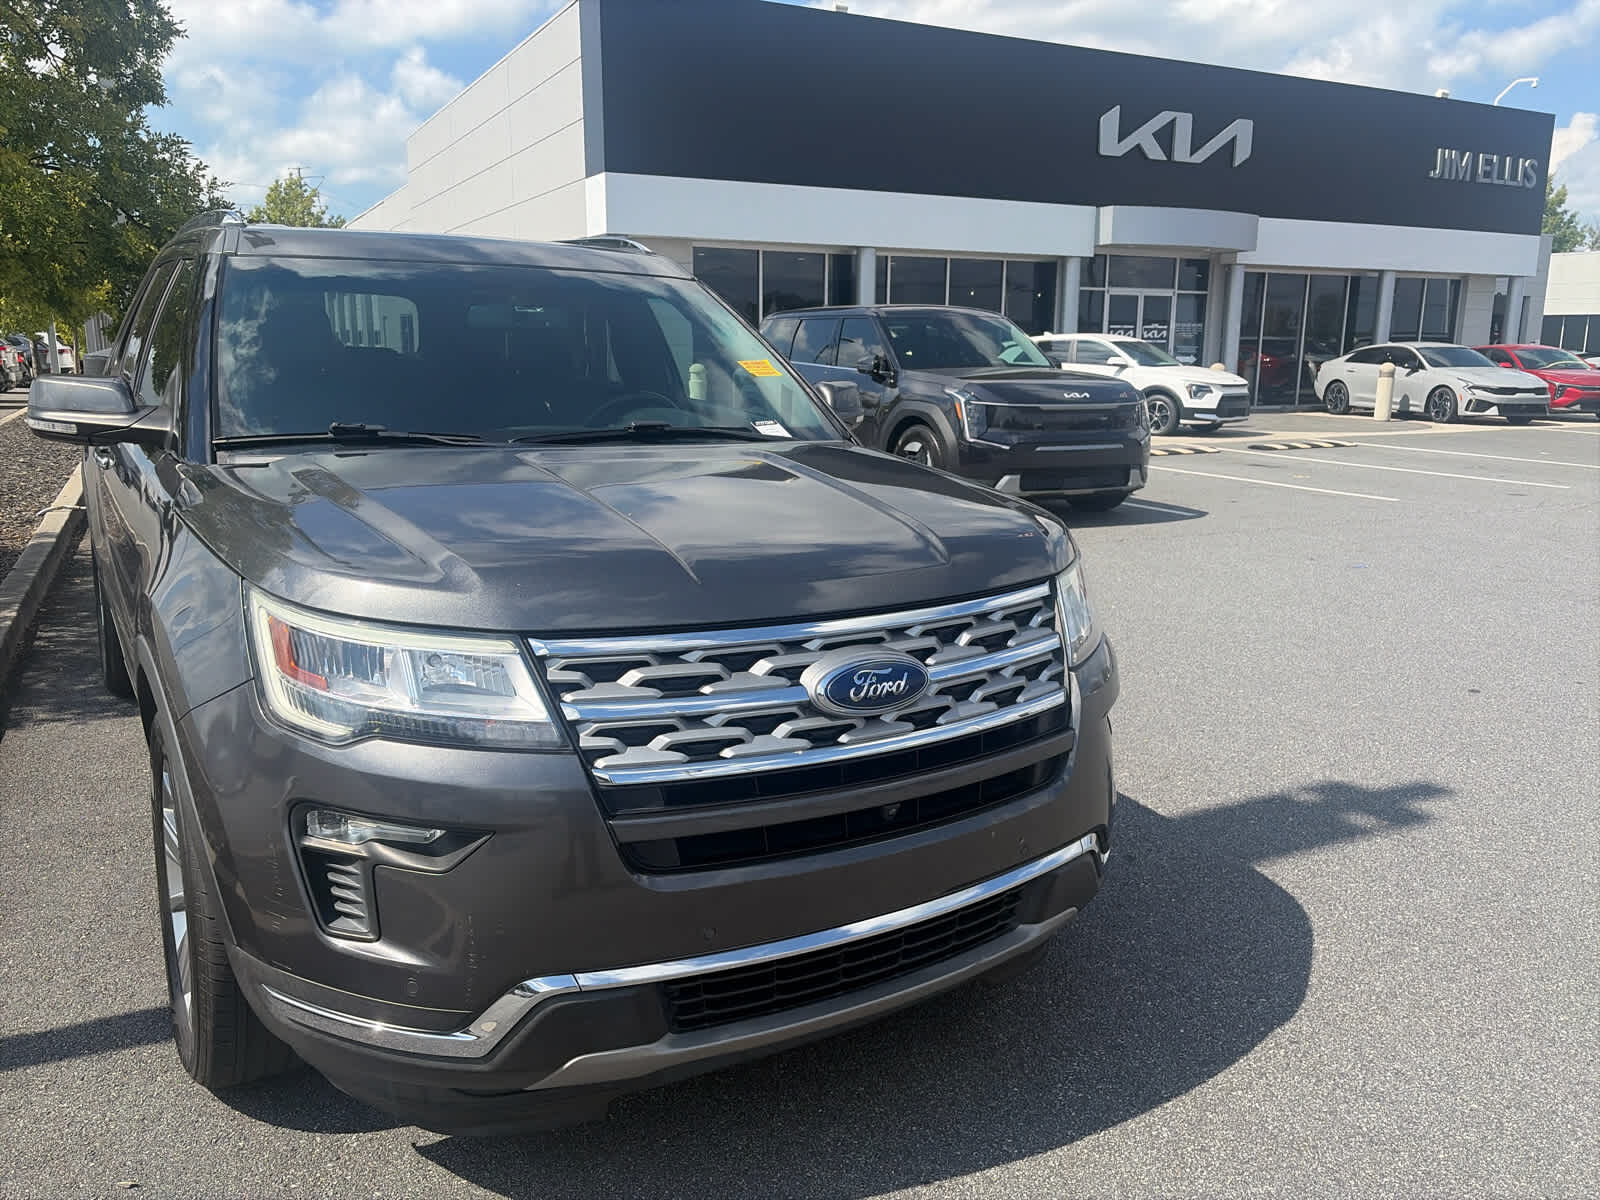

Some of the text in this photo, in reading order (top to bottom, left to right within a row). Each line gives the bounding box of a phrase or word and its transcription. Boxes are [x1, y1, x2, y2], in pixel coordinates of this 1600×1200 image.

[1099, 104, 1254, 168] KIA
[1429, 147, 1539, 189] JIM ELLIS
[1143, 330, 1168, 338] KIA
[849, 667, 909, 702] Ford
